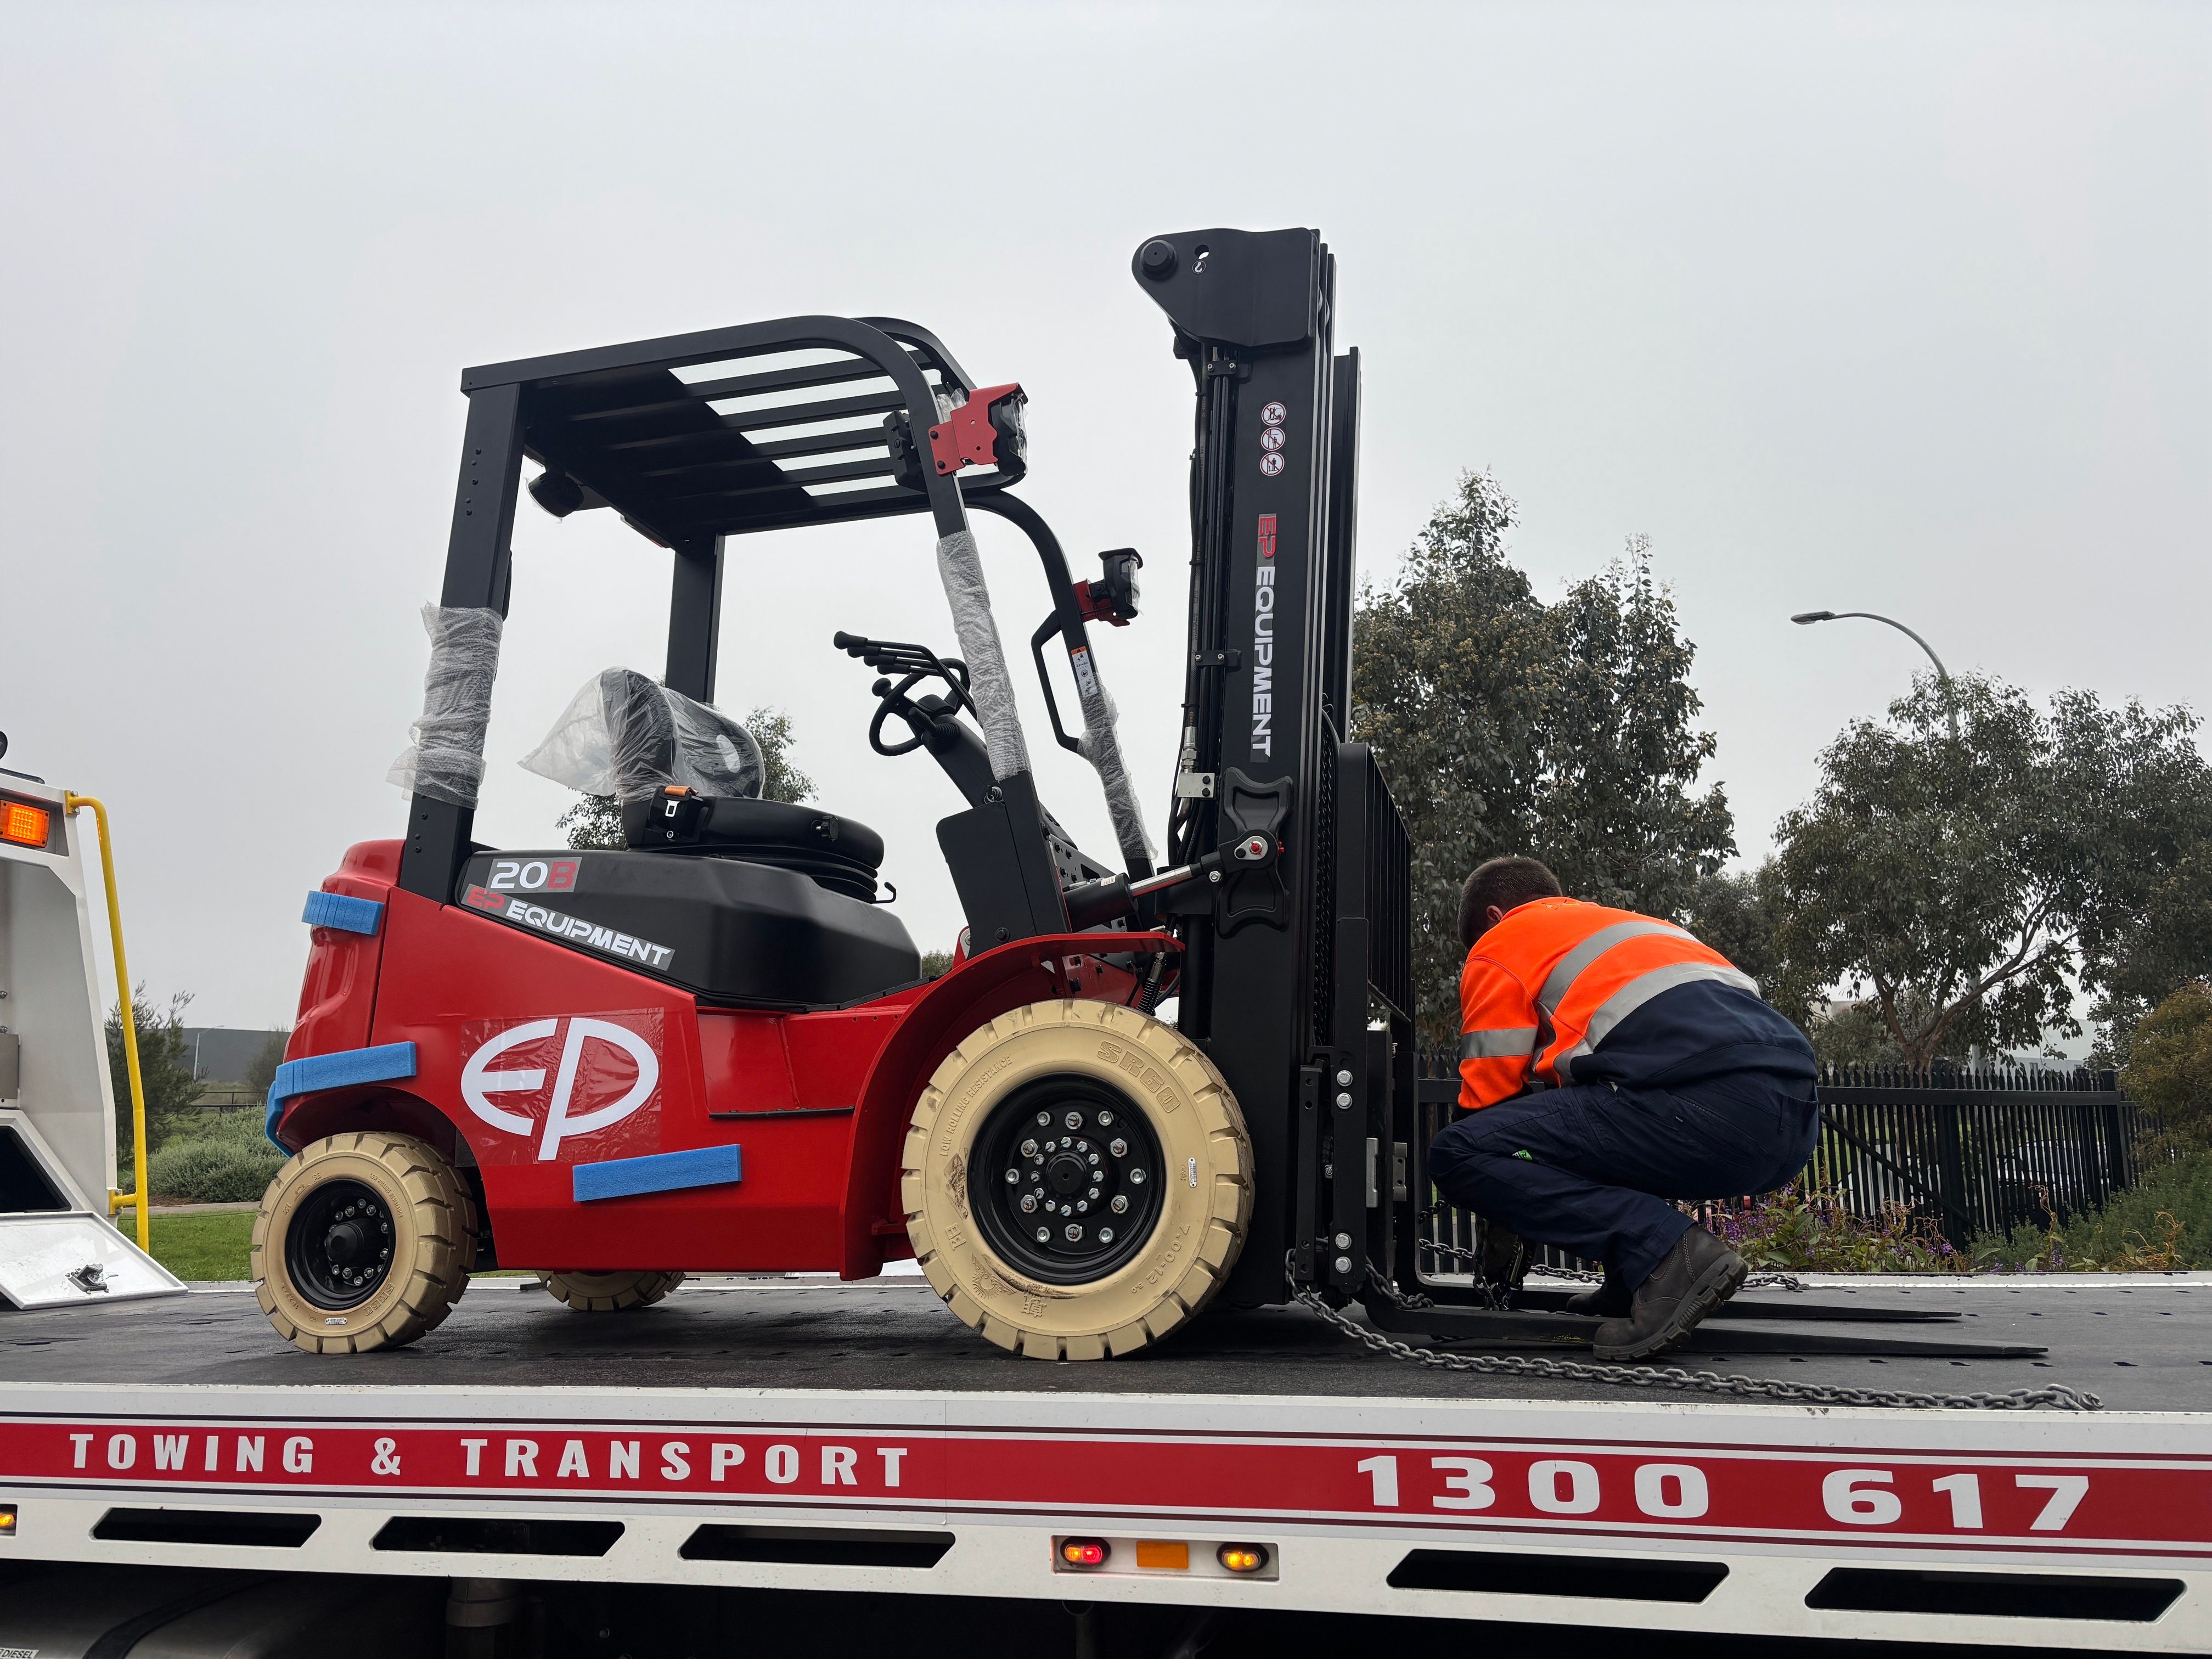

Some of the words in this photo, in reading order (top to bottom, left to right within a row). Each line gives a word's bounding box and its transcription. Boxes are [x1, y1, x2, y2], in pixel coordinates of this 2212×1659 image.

[1259, 517, 1276, 558] EP
[1252, 566, 1275, 757] EQUIPMENT
[490, 861, 577, 888] 20B
[466, 887, 504, 909] EP
[505, 899, 672, 966] EQUIPMENT
[460, 1017, 660, 1161] EP
[966, 1055, 1013, 1098] RESISTANCE
[1097, 1040, 1181, 1114] SR60
[945, 1097, 970, 1134] ROLLING
[939, 1137, 952, 1157] LOW
[1145, 1223, 1190, 1284] 7.00-12
[69, 1433, 313, 1474] TOWING
[371, 1437, 401, 1476] &
[460, 1438, 908, 1487] TRANSPORT
[1357, 1455, 1709, 1519] 1300
[1821, 1469, 2090, 1531] 617
